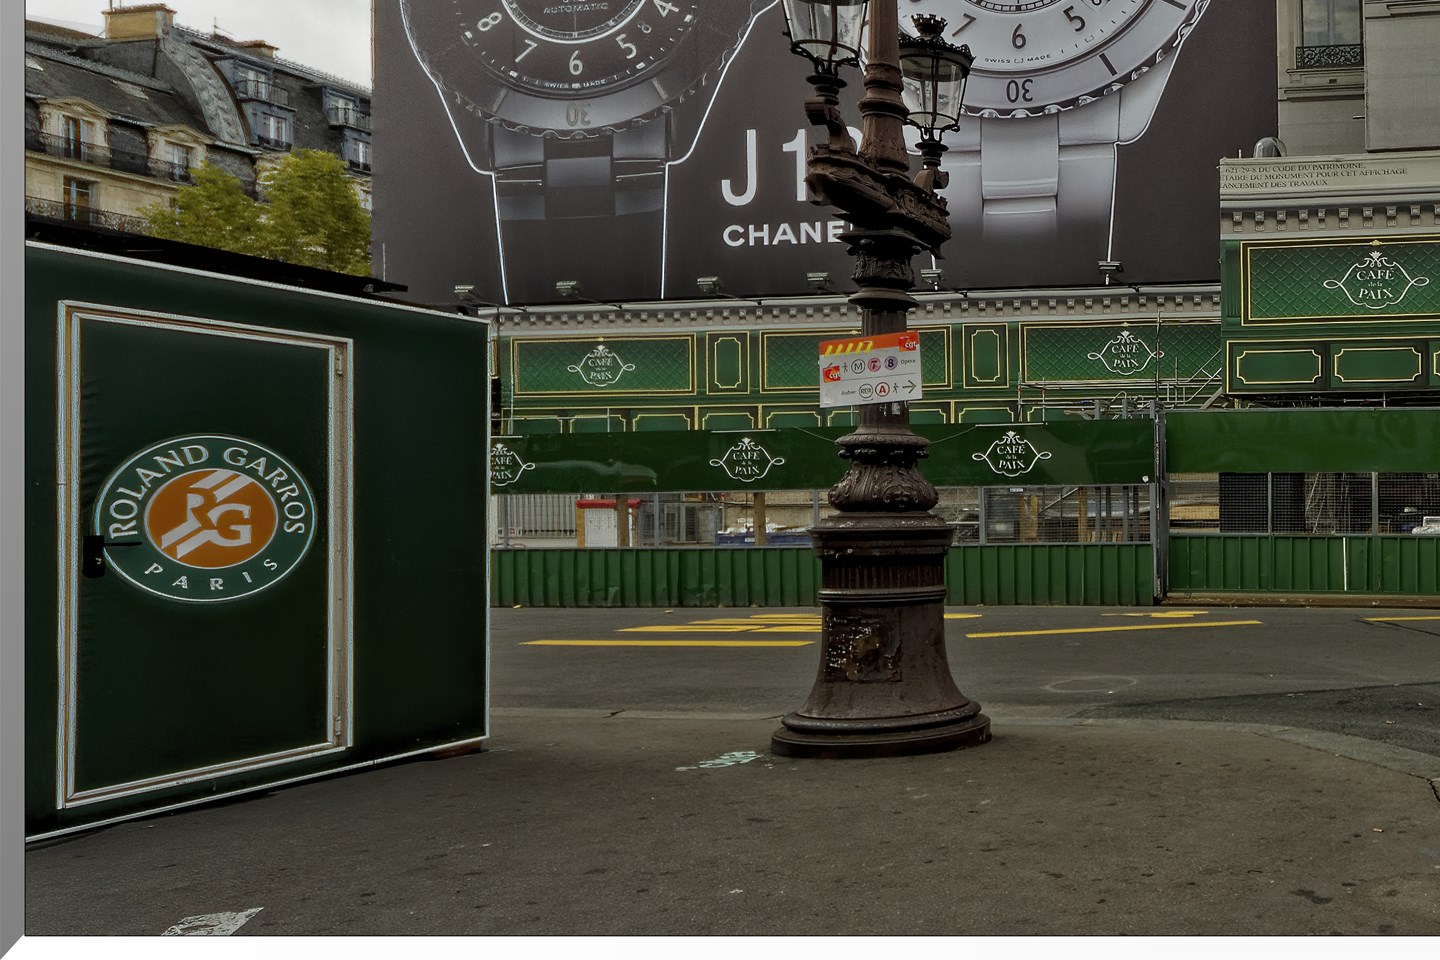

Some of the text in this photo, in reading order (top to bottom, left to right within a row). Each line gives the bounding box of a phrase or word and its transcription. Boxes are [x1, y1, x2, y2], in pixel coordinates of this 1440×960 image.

[543, 2, 609, 14] AUTOMATIC
[477, 12, 503, 32] 8
[952, 13, 976, 37] 7
[1063, 6, 1085, 32] 5
[1011, 23, 1026, 49] 6
[515, 39, 538, 62] 7
[615, 34, 636, 59] 5
[569, 50, 583, 75] 6
[1027, 54, 1052, 63] MADE
[1006, 78, 1034, 103] 30
[1264, 171, 1314, 180] MONUMENT
[1359, 168, 1408, 176] AFFICHAGE
[1272, 164, 1296, 172] CODE
[1220, 179, 1328, 189] ANCEMENT DES TRAVAUX
[723, 220, 853, 247] CHANE
[1356, 267, 1395, 281] CAFÉ
[1358, 287, 1394, 300] PAIX
[1111, 343, 1140, 354] CAFÉ
[1113, 358, 1139, 368] PAIX
[589, 371, 613, 380] PAIX
[997, 444, 1026, 455] CAFÉ
[735, 465, 760, 475] PAIX
[998, 460, 1025, 470] PAIX
[108, 444, 306, 540] ROLAND GARROS
[143, 557, 279, 591] PARIS
